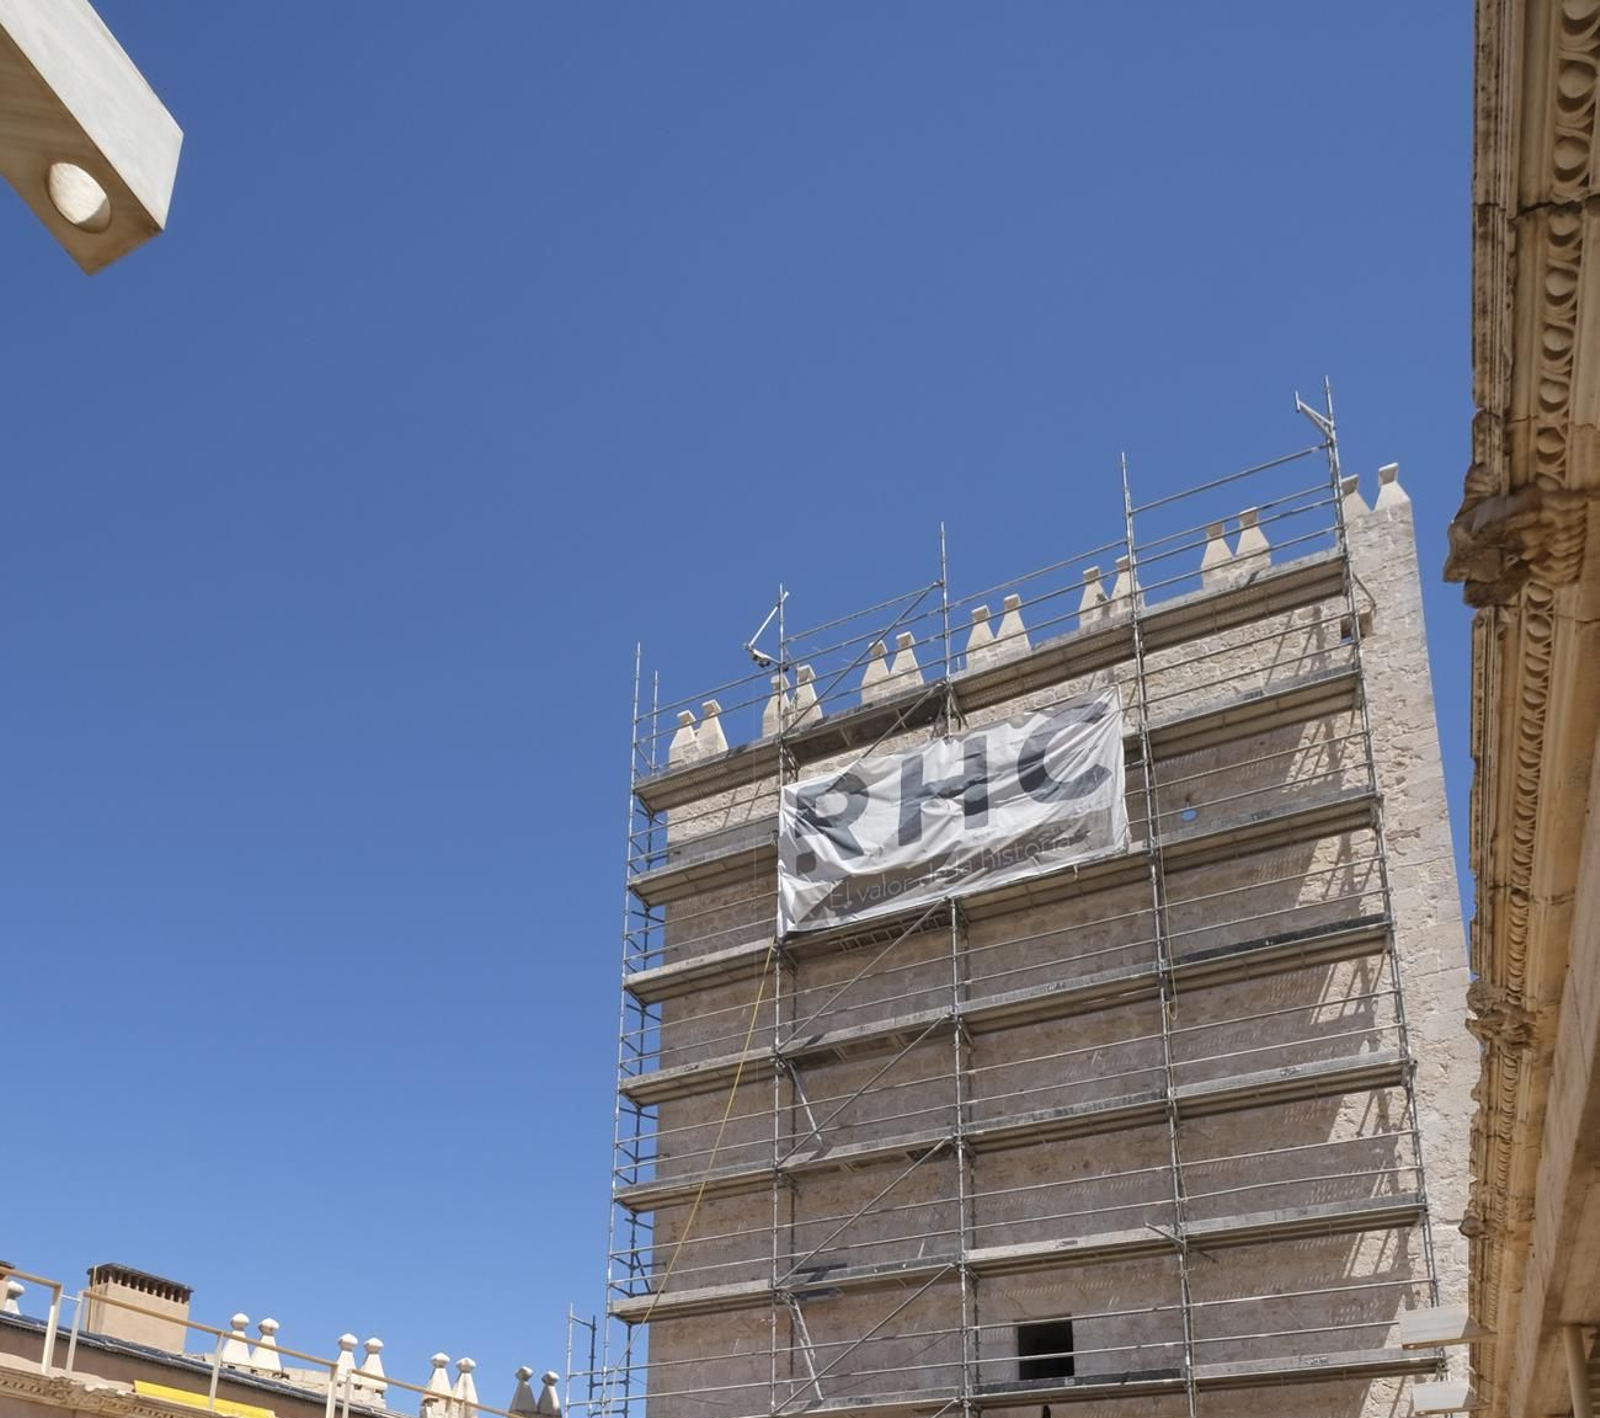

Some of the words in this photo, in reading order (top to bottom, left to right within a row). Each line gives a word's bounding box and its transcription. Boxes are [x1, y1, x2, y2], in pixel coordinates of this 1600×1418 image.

[796, 700, 1112, 856] RHC
[830, 880, 852, 909] El
[856, 872, 914, 902] valor
[980, 837, 1070, 870] historia
